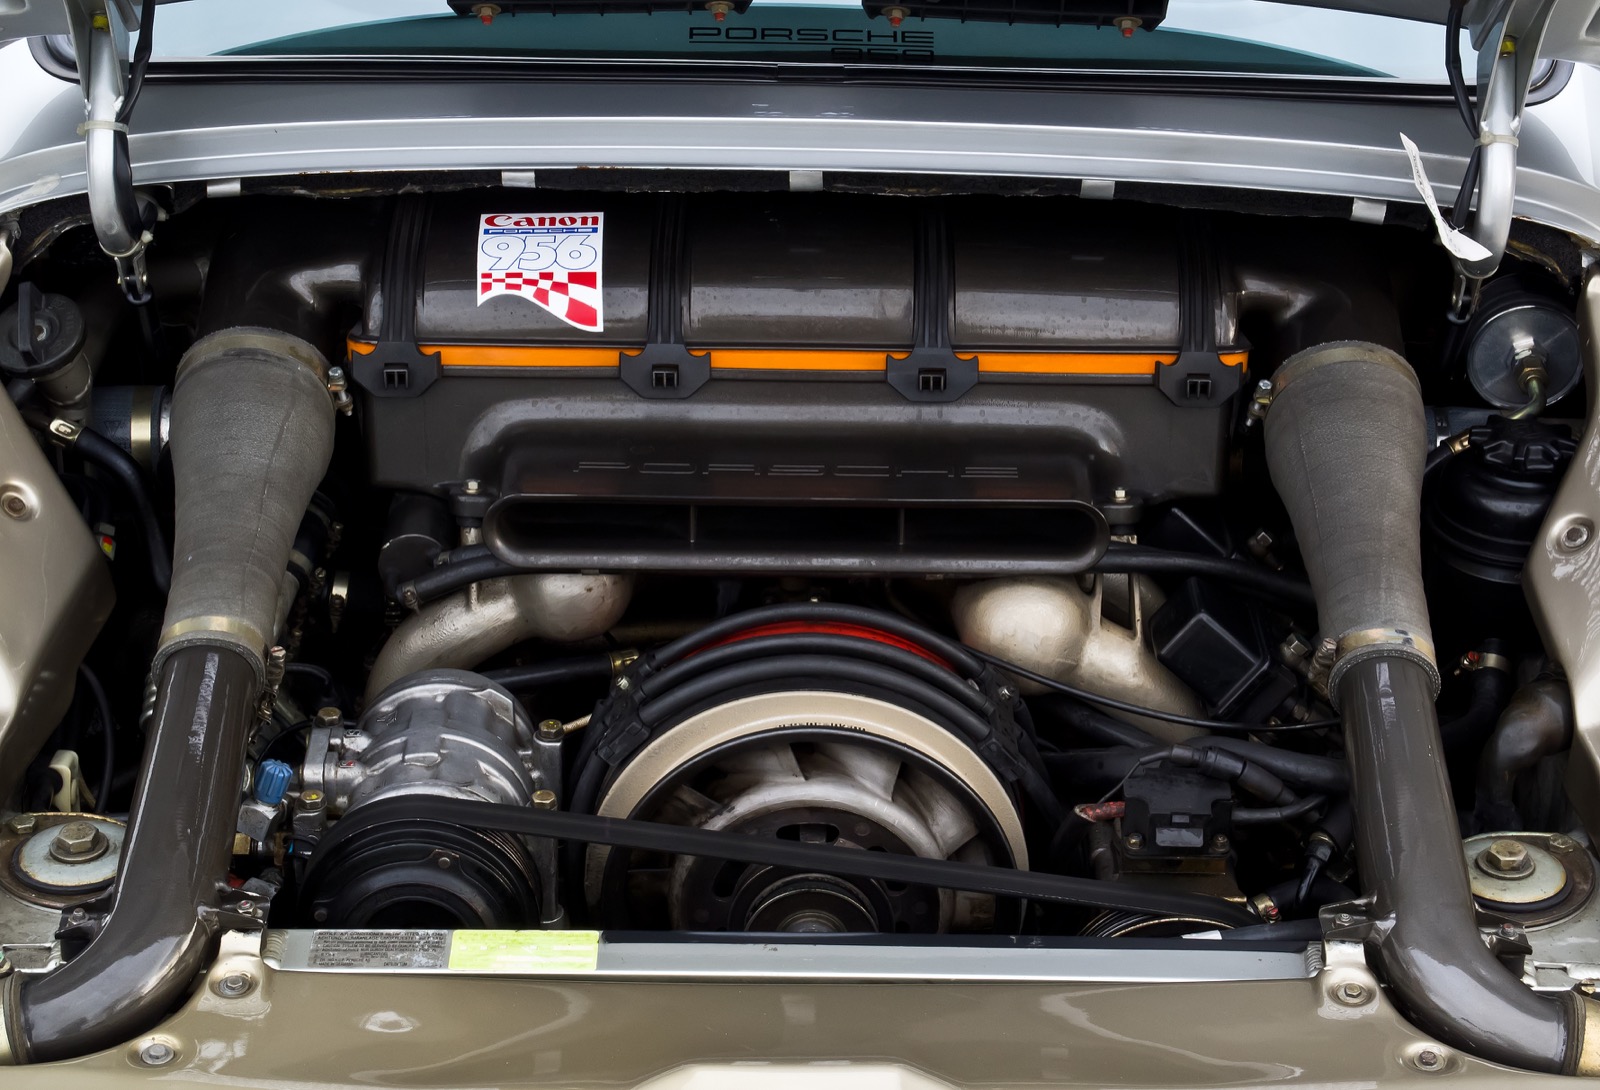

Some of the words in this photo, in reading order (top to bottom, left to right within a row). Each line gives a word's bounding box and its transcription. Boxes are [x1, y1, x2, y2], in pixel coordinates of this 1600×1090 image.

[689, 27, 934, 44] PORSCHE
[484, 215, 599, 227] Canon
[481, 235, 597, 271] 956
[573, 461, 1019, 478] PORSCHE
